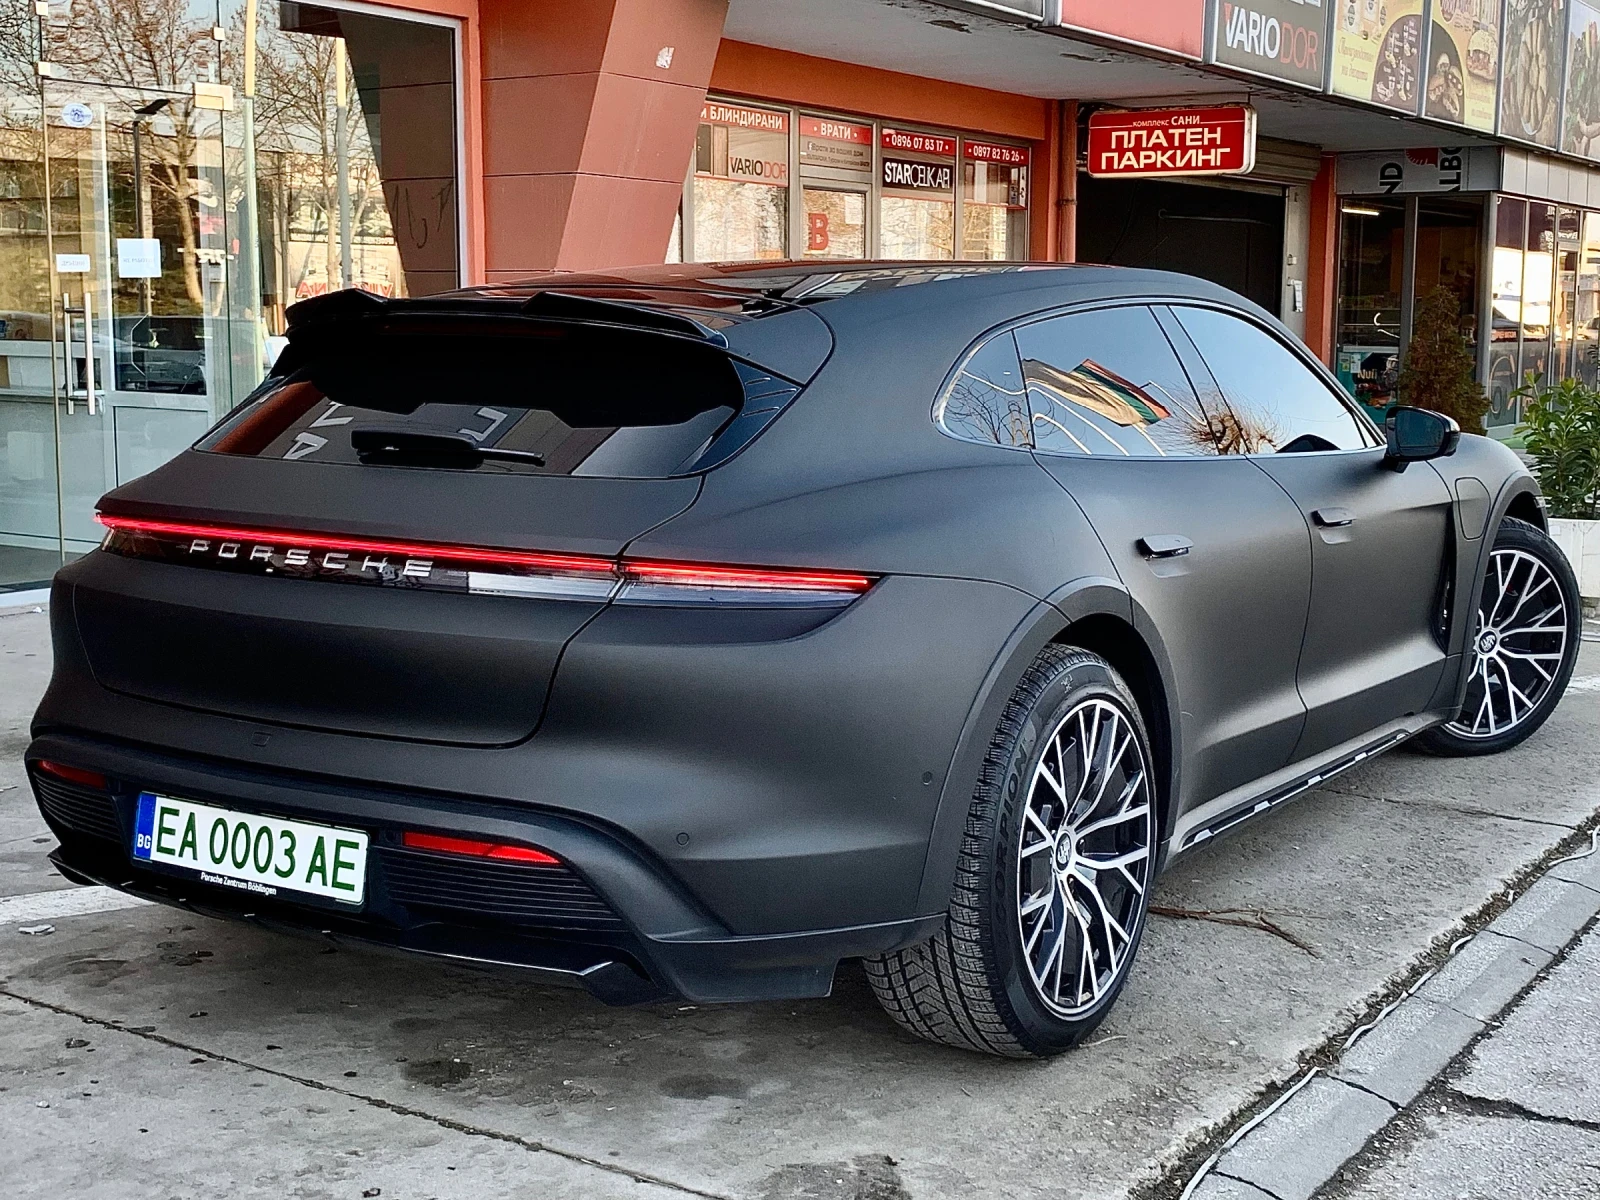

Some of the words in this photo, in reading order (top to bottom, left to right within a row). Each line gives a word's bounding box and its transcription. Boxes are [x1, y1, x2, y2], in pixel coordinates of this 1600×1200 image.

[1223, 3, 1319, 72] VARIODOR
[709, 105, 783, 130] БЛИНДИРАНИ
[1132, 119, 1170, 127] комплекс
[1170, 115, 1201, 126] САНИ
[820, 122, 851, 140] ВРАТИ
[1110, 127, 1222, 149] ПЛАТЕН
[891, 134, 912, 148] 0896
[913, 137, 924, 149] 07
[924, 138, 935, 151] 83
[936, 140, 944, 152] 17
[973, 145, 991, 158] 0897
[991, 147, 1001, 159] 82
[1001, 149, 1011, 161] 76
[1011, 150, 1020, 162] 26
[729, 156, 787, 180] VARIODOR
[1101, 148, 1231, 170] ПАРКИНГ
[189, 539, 434, 577] PORSCHE
[136, 833, 152, 850] BG
[156, 805, 199, 861] EA
[209, 817, 297, 879] 0003
[305, 835, 360, 892] AE
[200, 871, 223, 885] Porsche
[223, 876, 248, 890] Zentrum
[247, 881, 277, 896] Böblingen
